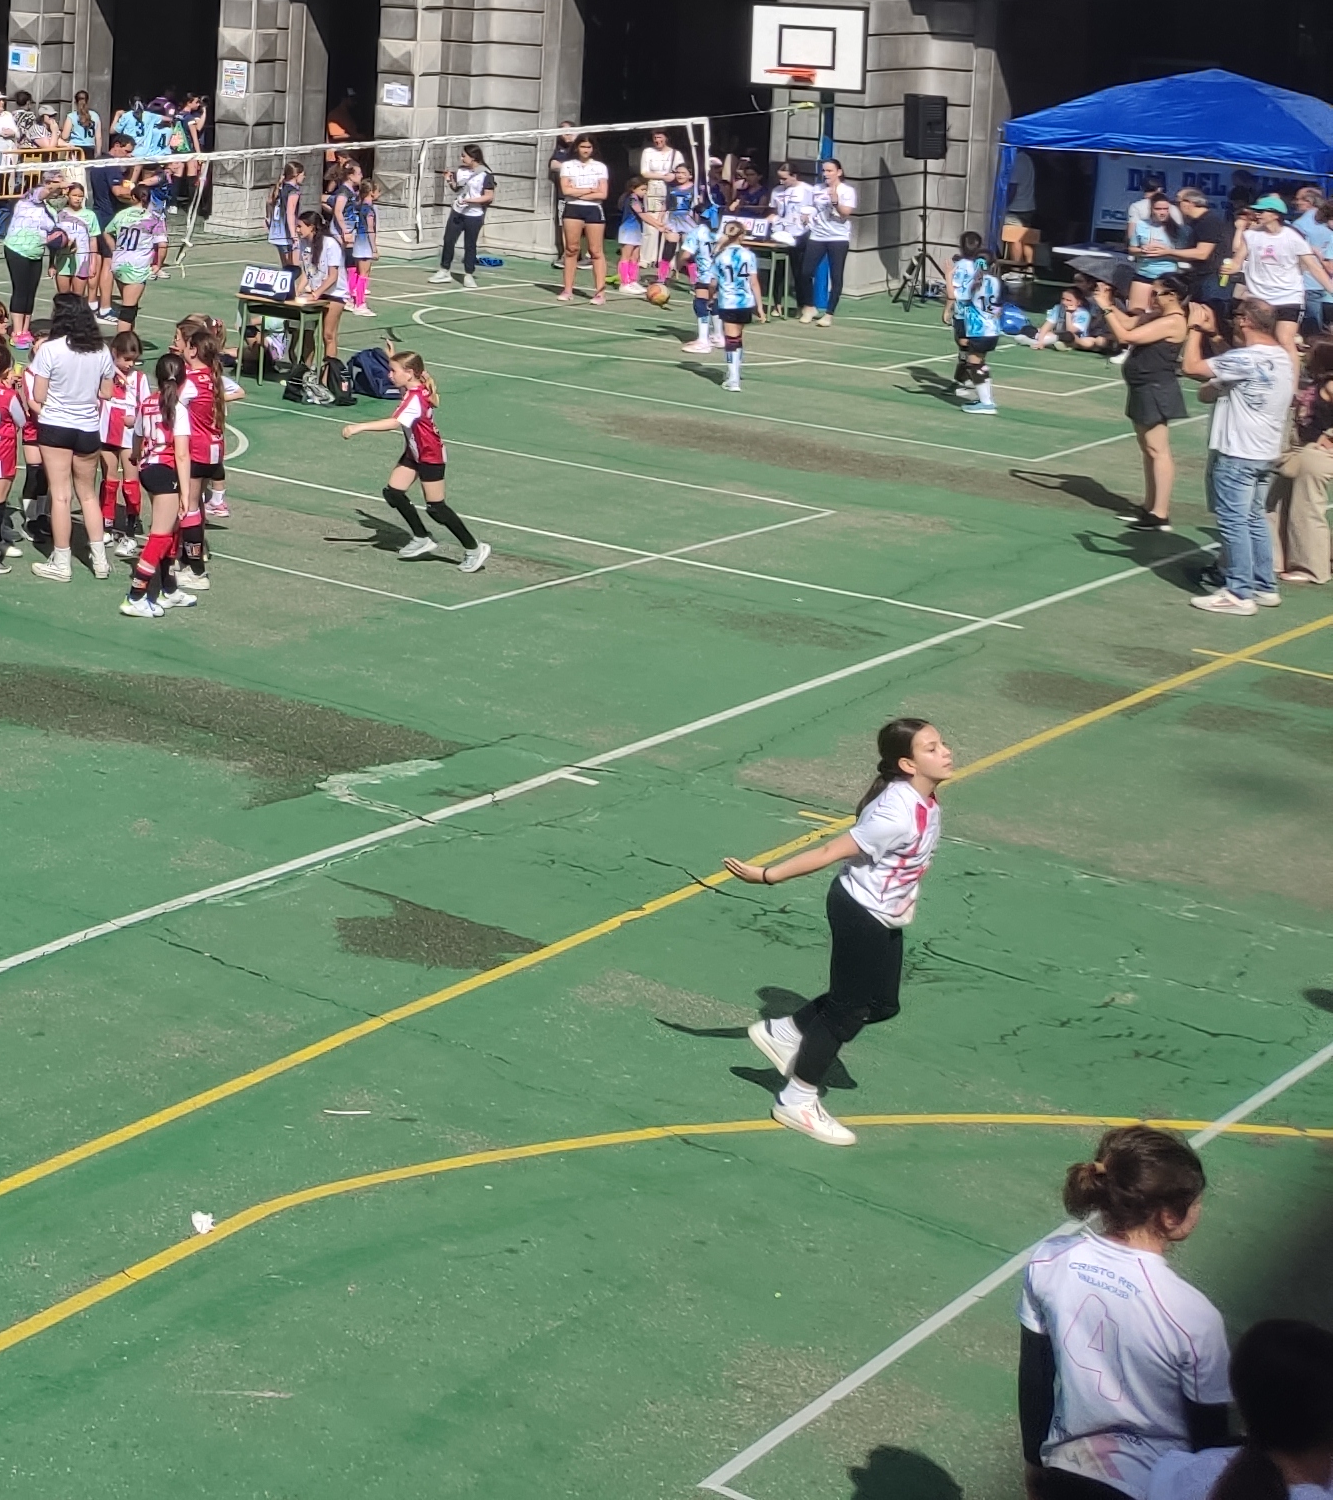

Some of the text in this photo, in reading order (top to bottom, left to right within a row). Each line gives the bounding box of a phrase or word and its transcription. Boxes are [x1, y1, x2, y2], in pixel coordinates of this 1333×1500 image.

[1183, 170, 1227, 196] DEL
[118, 226, 141, 251] 20
[755, 223, 765, 234] 10
[725, 262, 750, 283] 14
[1069, 1261, 1142, 1296] CRISTO REY
[1063, 1293, 1122, 1402] 4
